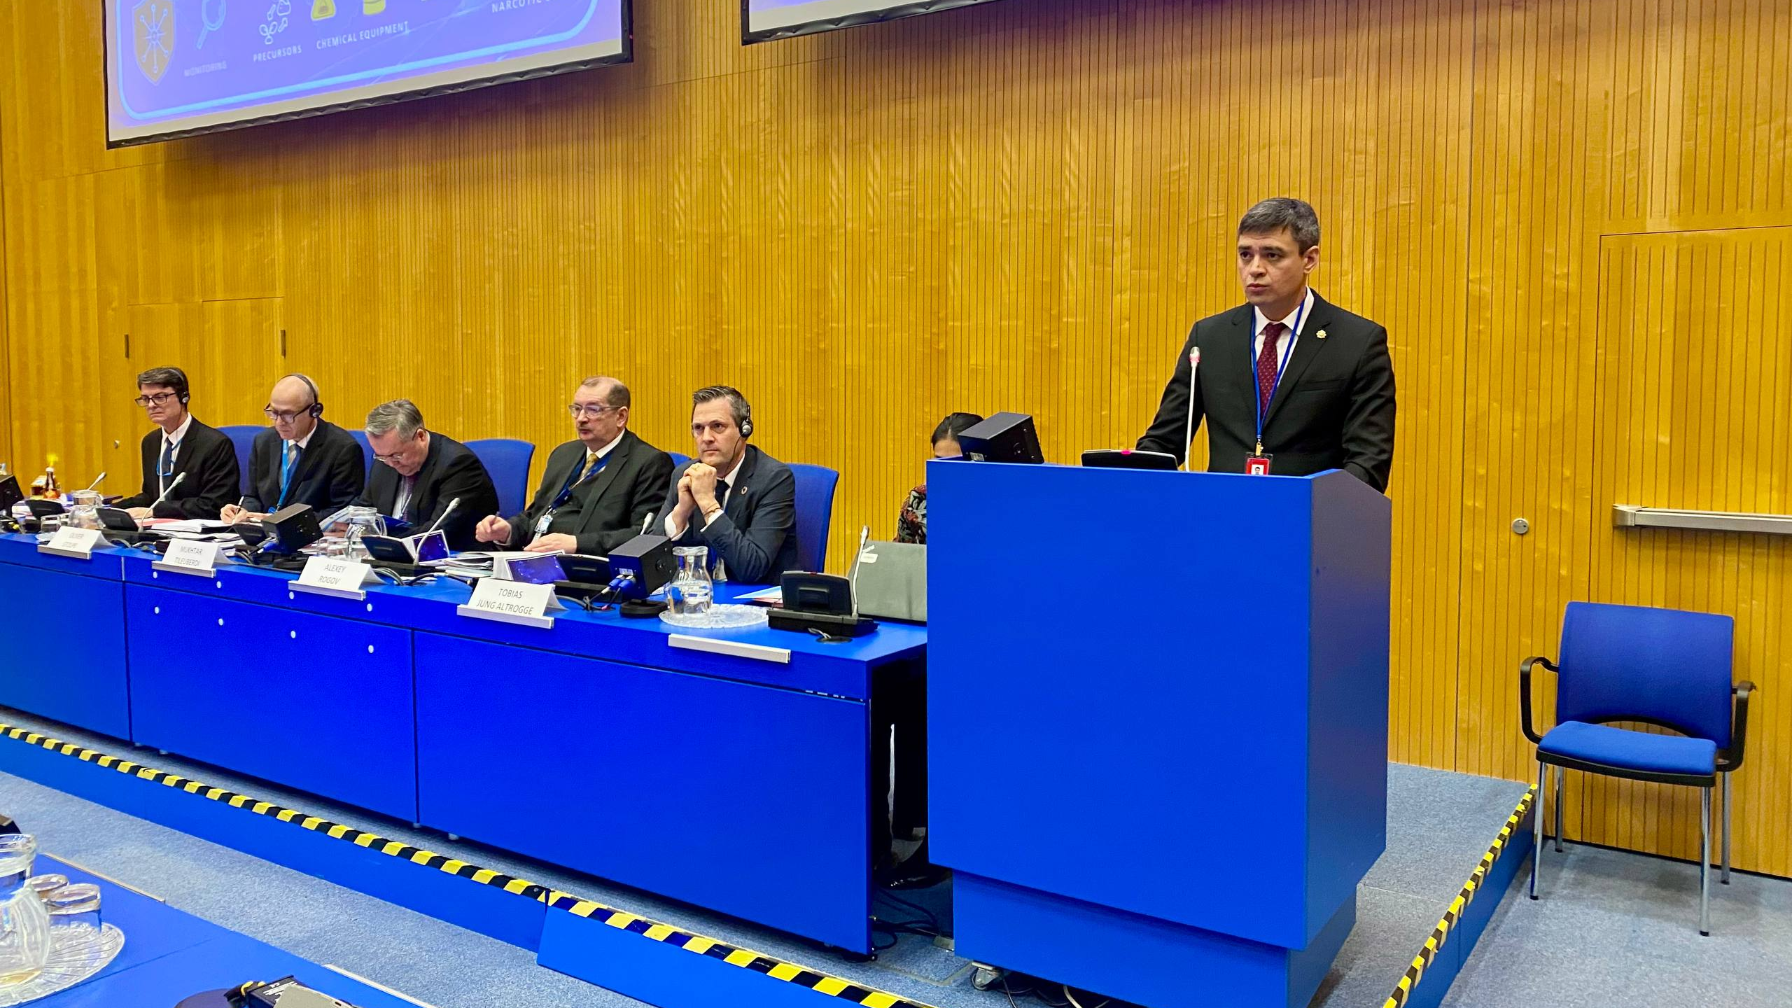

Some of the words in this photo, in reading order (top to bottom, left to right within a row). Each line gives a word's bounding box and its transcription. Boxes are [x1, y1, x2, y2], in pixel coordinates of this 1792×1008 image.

[316, 33, 358, 50] CHEMICAL
[359, 21, 408, 40] EQUIPMENT
[253, 45, 302, 62] PRECURSORS
[181, 546, 203, 555] MUKHTAR
[324, 564, 347, 573] ALEXEY
[318, 575, 340, 585] ROGOV
[498, 588, 523, 599] TOBIAS
[476, 599, 496, 610] JUNG
[496, 602, 534, 616] ALTROGGE
